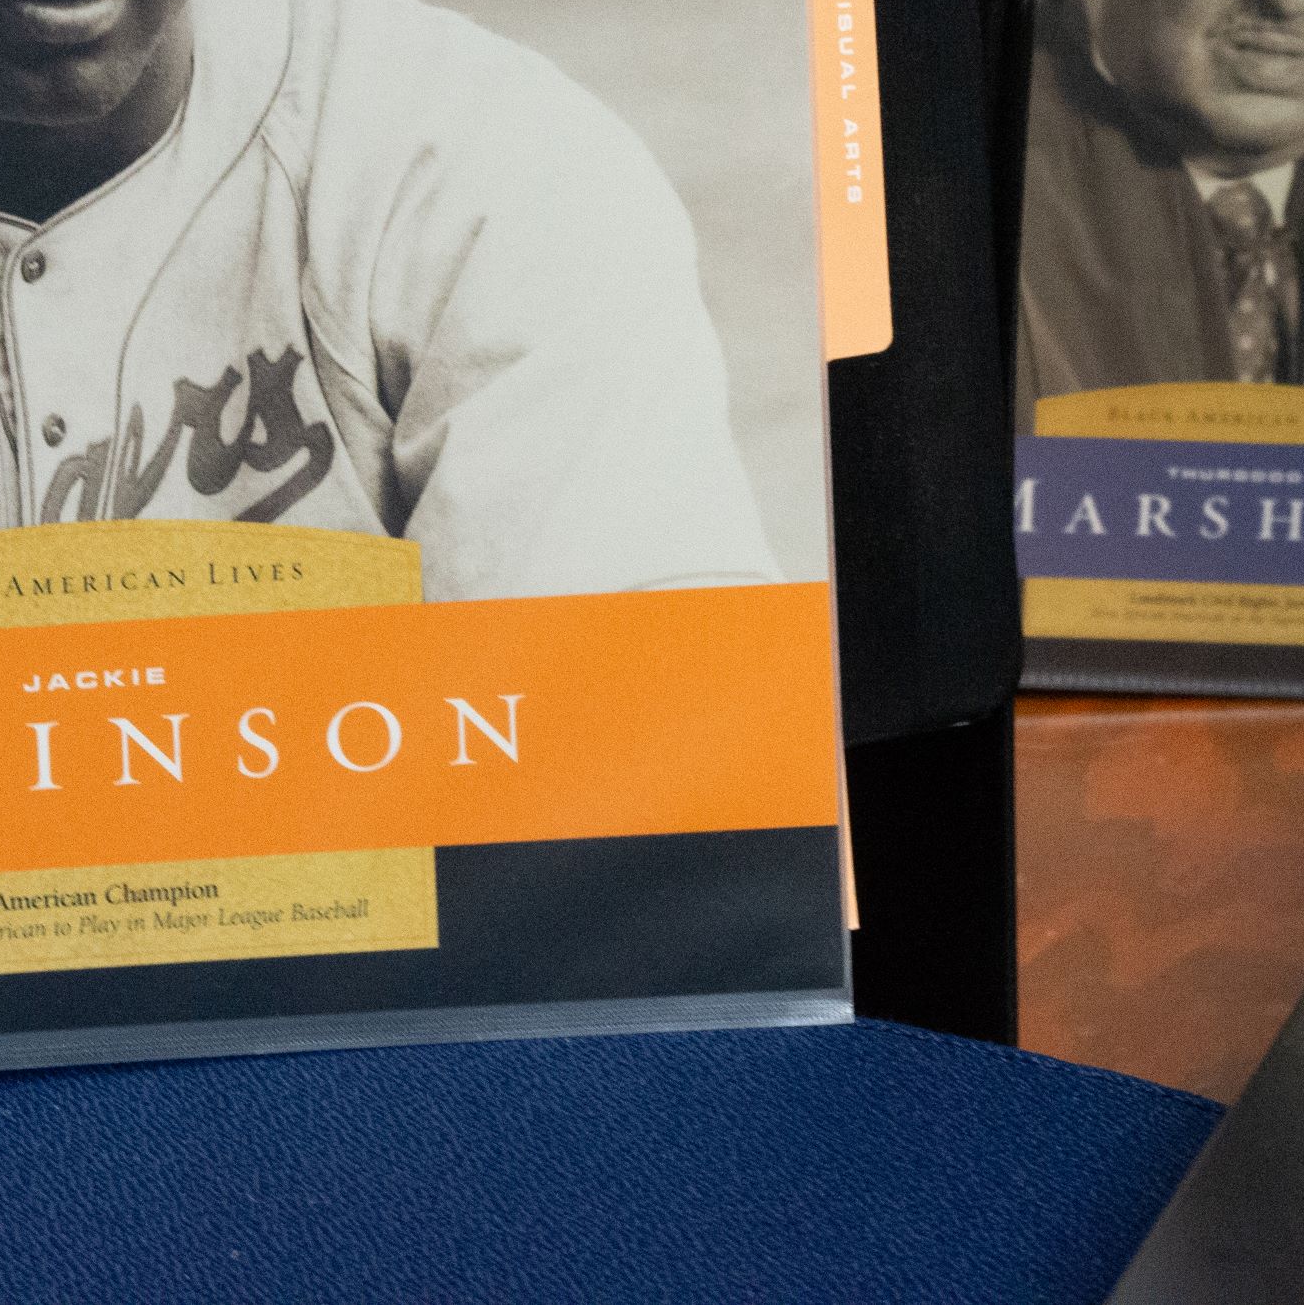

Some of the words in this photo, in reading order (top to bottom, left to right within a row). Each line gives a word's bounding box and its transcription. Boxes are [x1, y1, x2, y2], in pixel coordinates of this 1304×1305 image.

[842, 117, 863, 205] ARTS
[22, 666, 167, 694] JACKIE
[104, 880, 219, 908] Champion
[52, 916, 72, 937] to
[78, 911, 120, 940] Play
[126, 912, 147, 933] in
[152, 906, 211, 936] Major
[217, 901, 283, 931] League
[290, 895, 370, 922] Baseball
